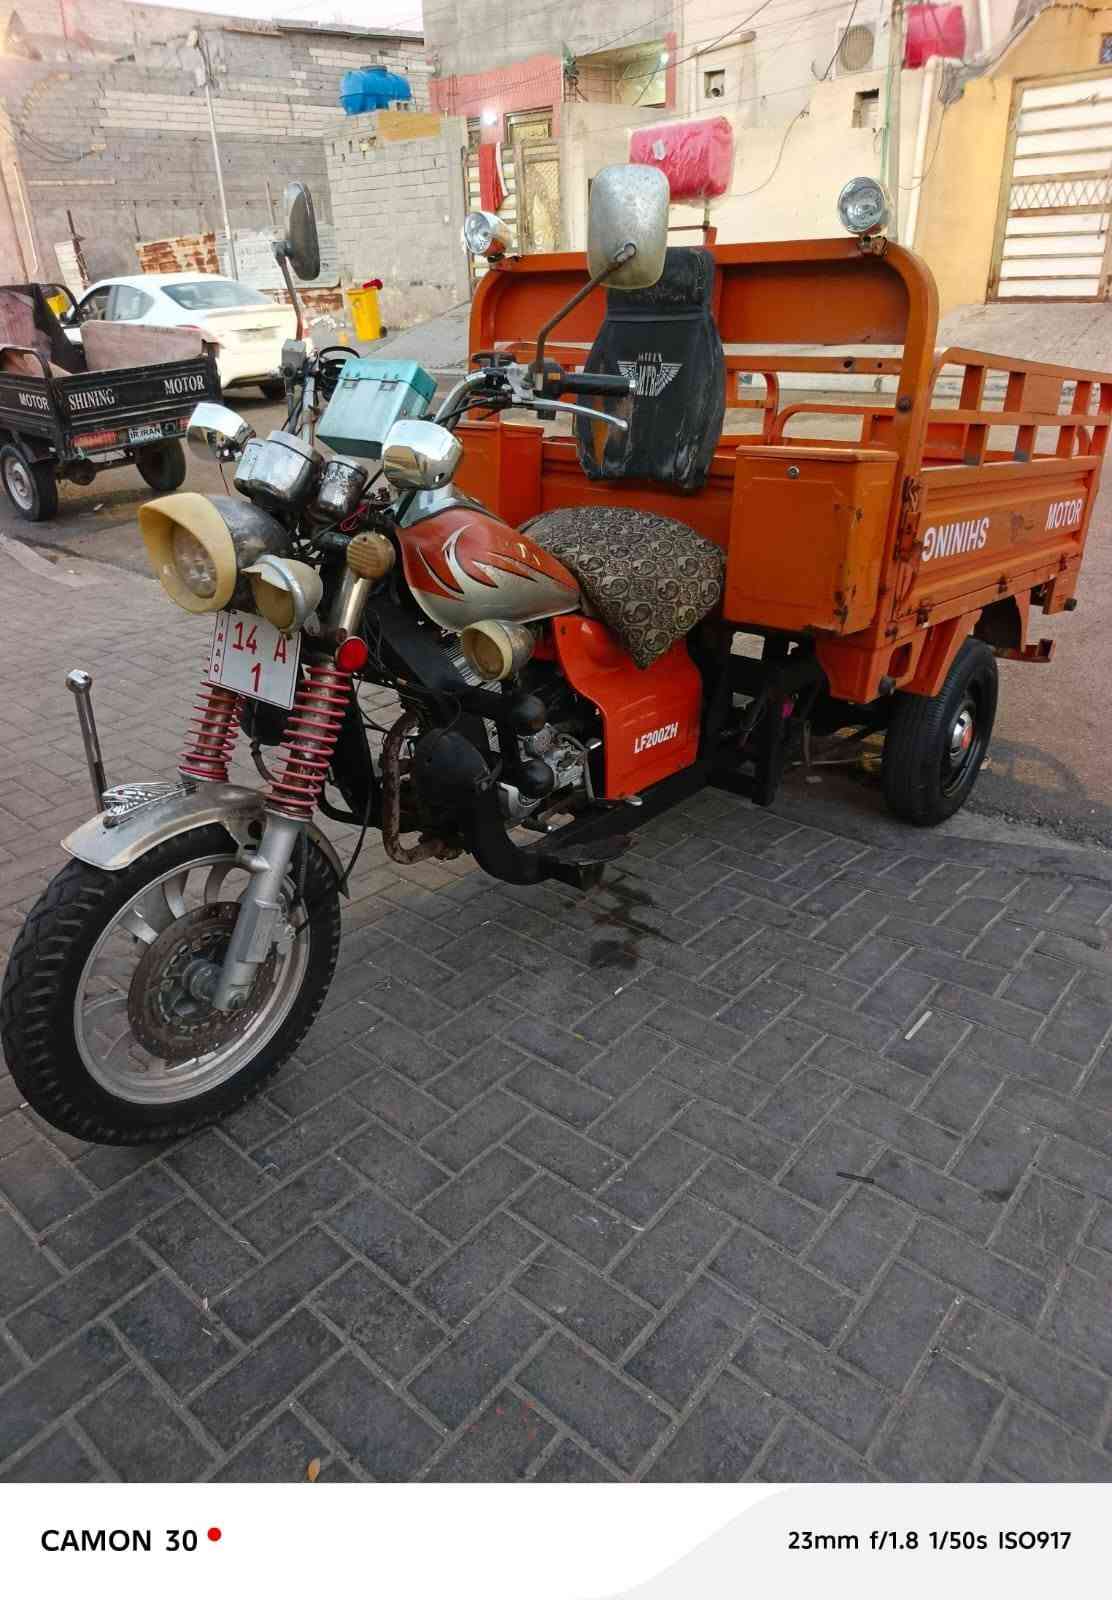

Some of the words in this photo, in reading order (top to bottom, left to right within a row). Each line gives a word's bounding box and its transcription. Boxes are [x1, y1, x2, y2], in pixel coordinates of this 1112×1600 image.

[18, 392, 50, 411] MOTOR
[68, 388, 115, 411] SHINING
[164, 375, 205, 396] MOTOR
[1045, 498, 1084, 531] MOTOR
[922, 517, 989, 562] SHINING
[233, 622, 257, 655] 14
[273, 633, 288, 664] A
[251, 662, 261, 693] 1
[633, 721, 679, 754] LF200ZH
